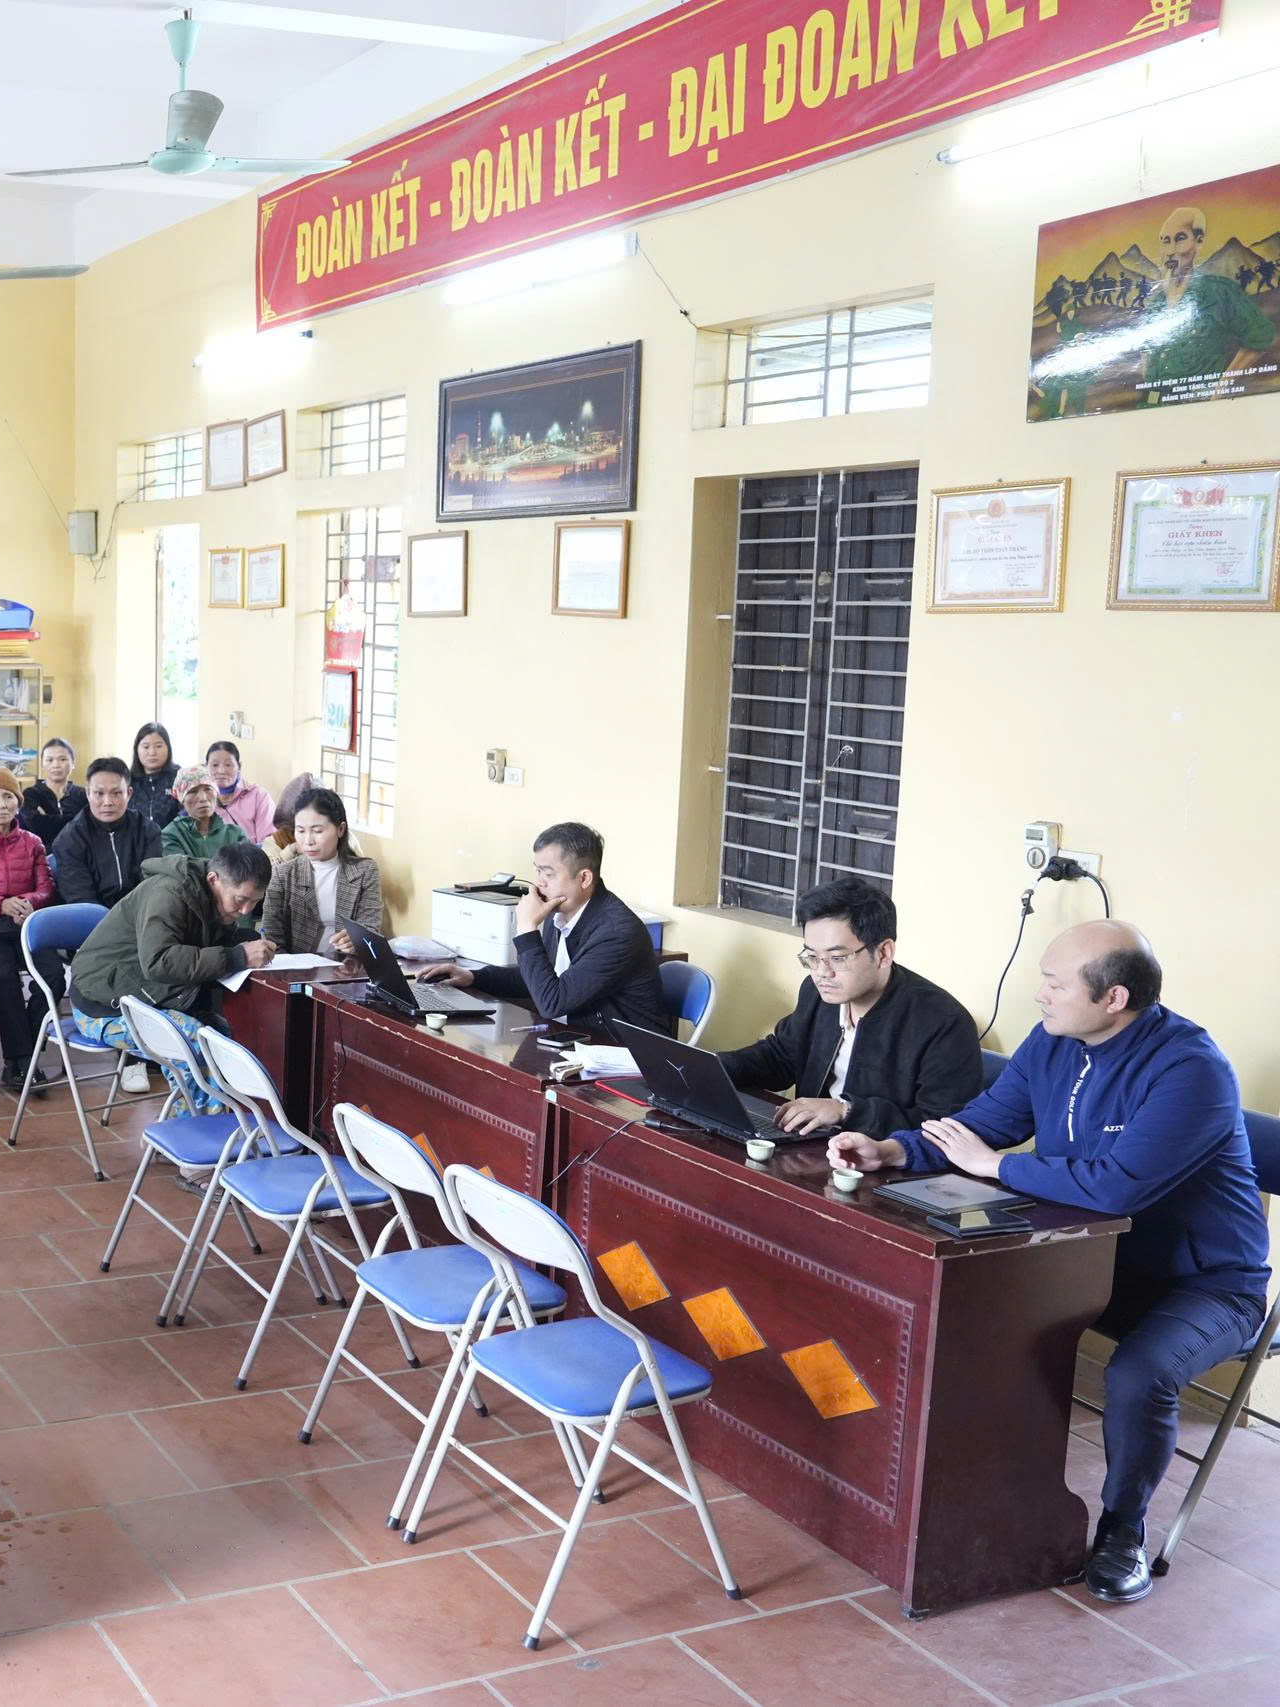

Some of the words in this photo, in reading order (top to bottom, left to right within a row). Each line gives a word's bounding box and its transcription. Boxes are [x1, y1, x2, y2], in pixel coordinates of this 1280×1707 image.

[295, 196, 363, 284] ĐOÀN
[370, 159, 421, 259] KẾT
[449, 125, 543, 232] ĐOÀN
[554, 74, 627, 198] KẾT
[668, 43, 748, 164] ĐẠI
[1244, 367, 1258, 375] LẬP
[1258, 364, 1278, 373] ĐẢNG
[1195, 529, 1224, 538] KHEN
[1072, 1079, 1083, 1094] TOUR
